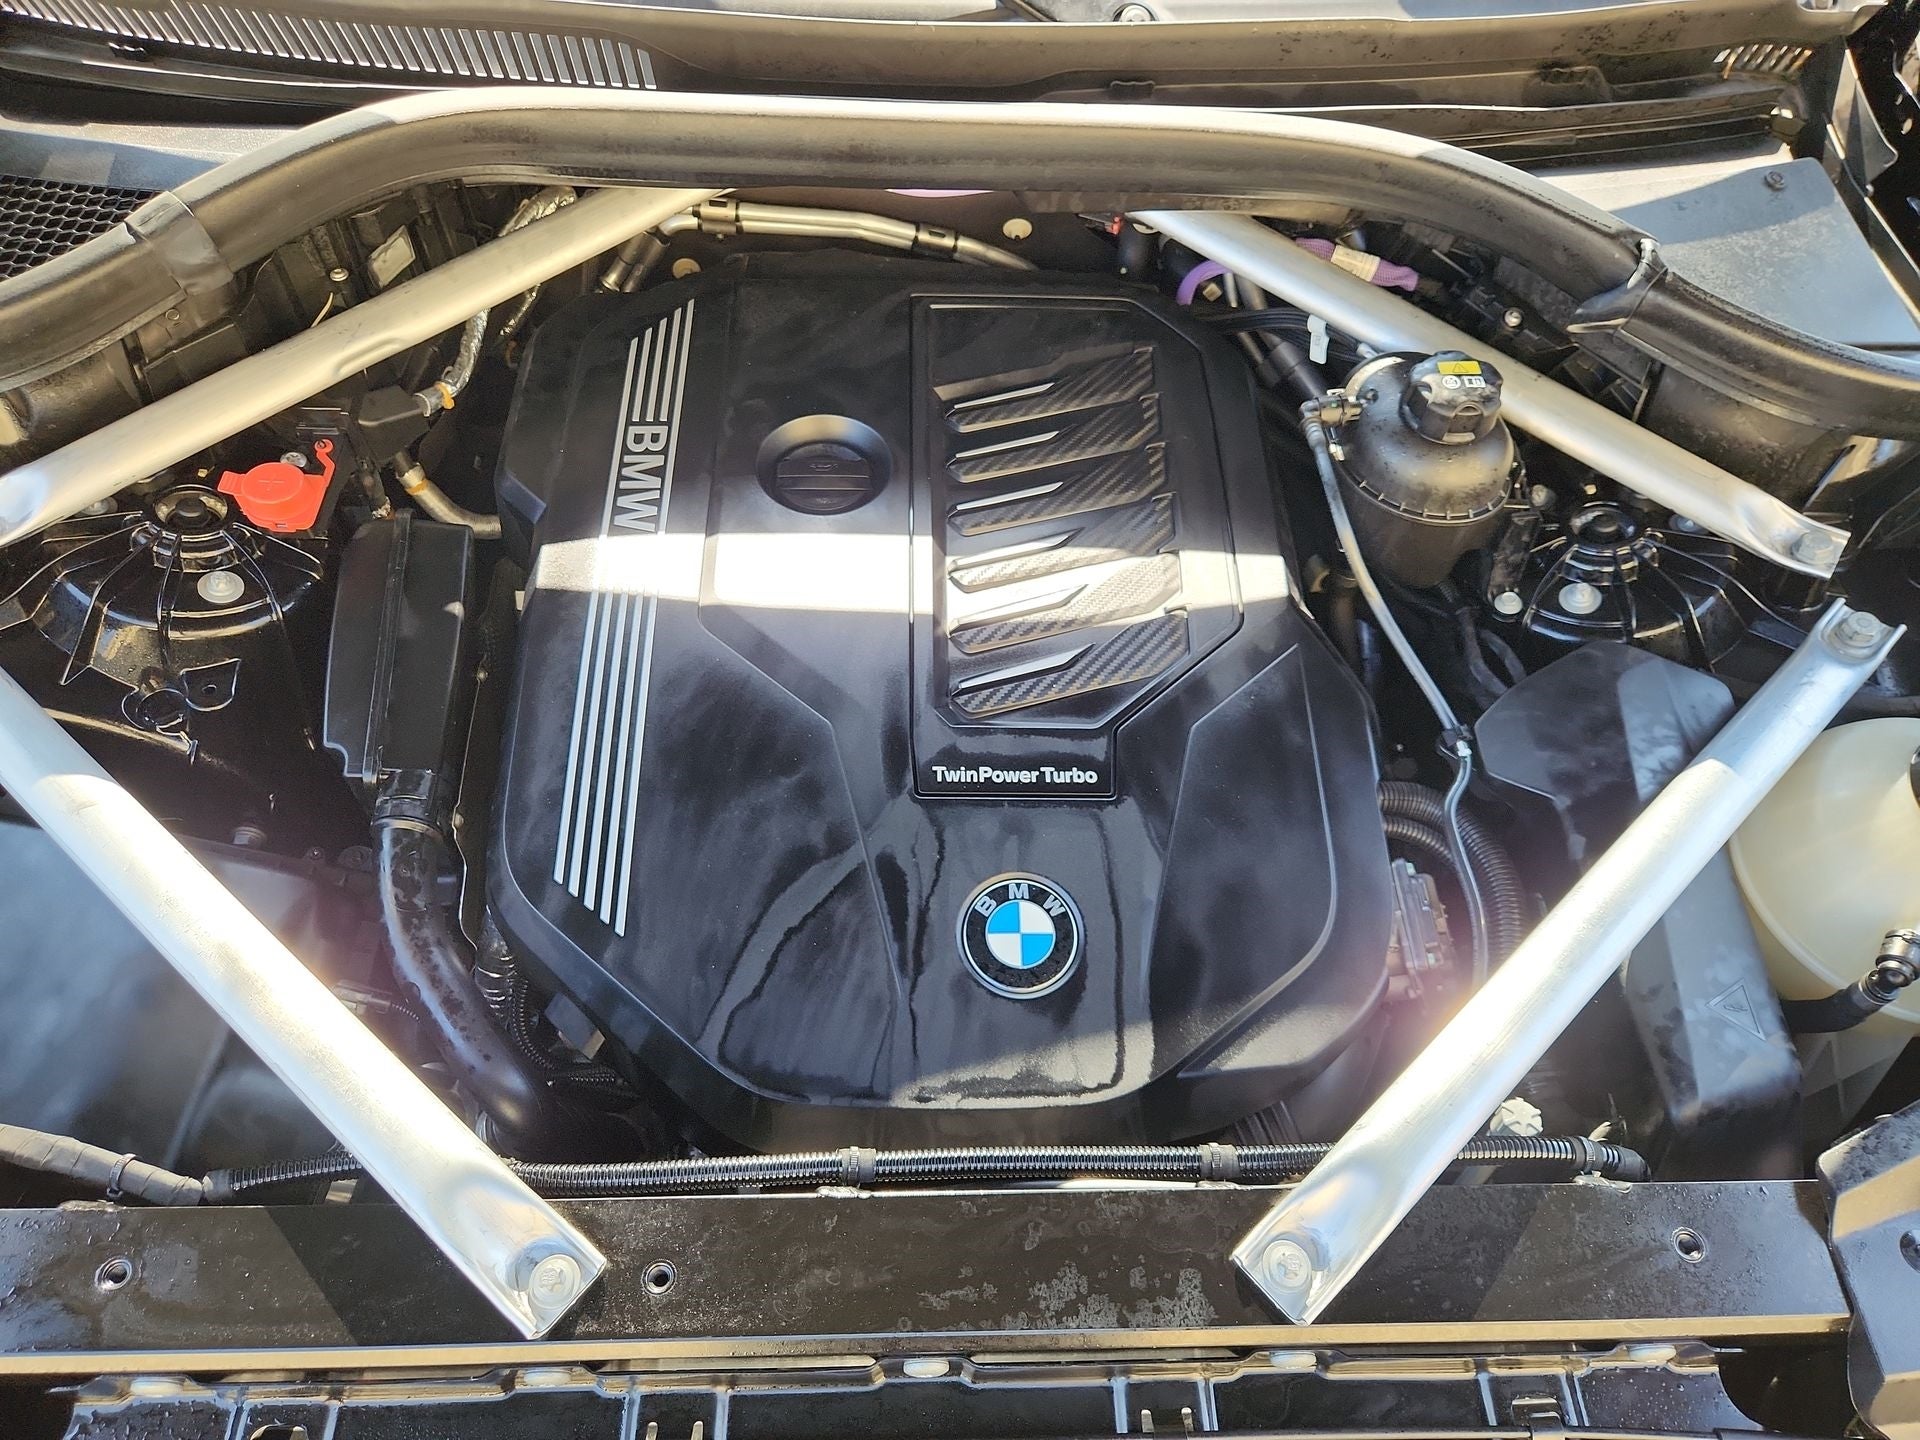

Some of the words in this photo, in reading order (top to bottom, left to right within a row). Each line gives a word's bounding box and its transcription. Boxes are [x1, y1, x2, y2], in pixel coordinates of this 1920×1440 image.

[614, 426, 669, 532] BMW
[932, 766, 1039, 784] TwinPower
[1040, 767, 1098, 784] Turbo
[975, 884, 1065, 917] BMW
